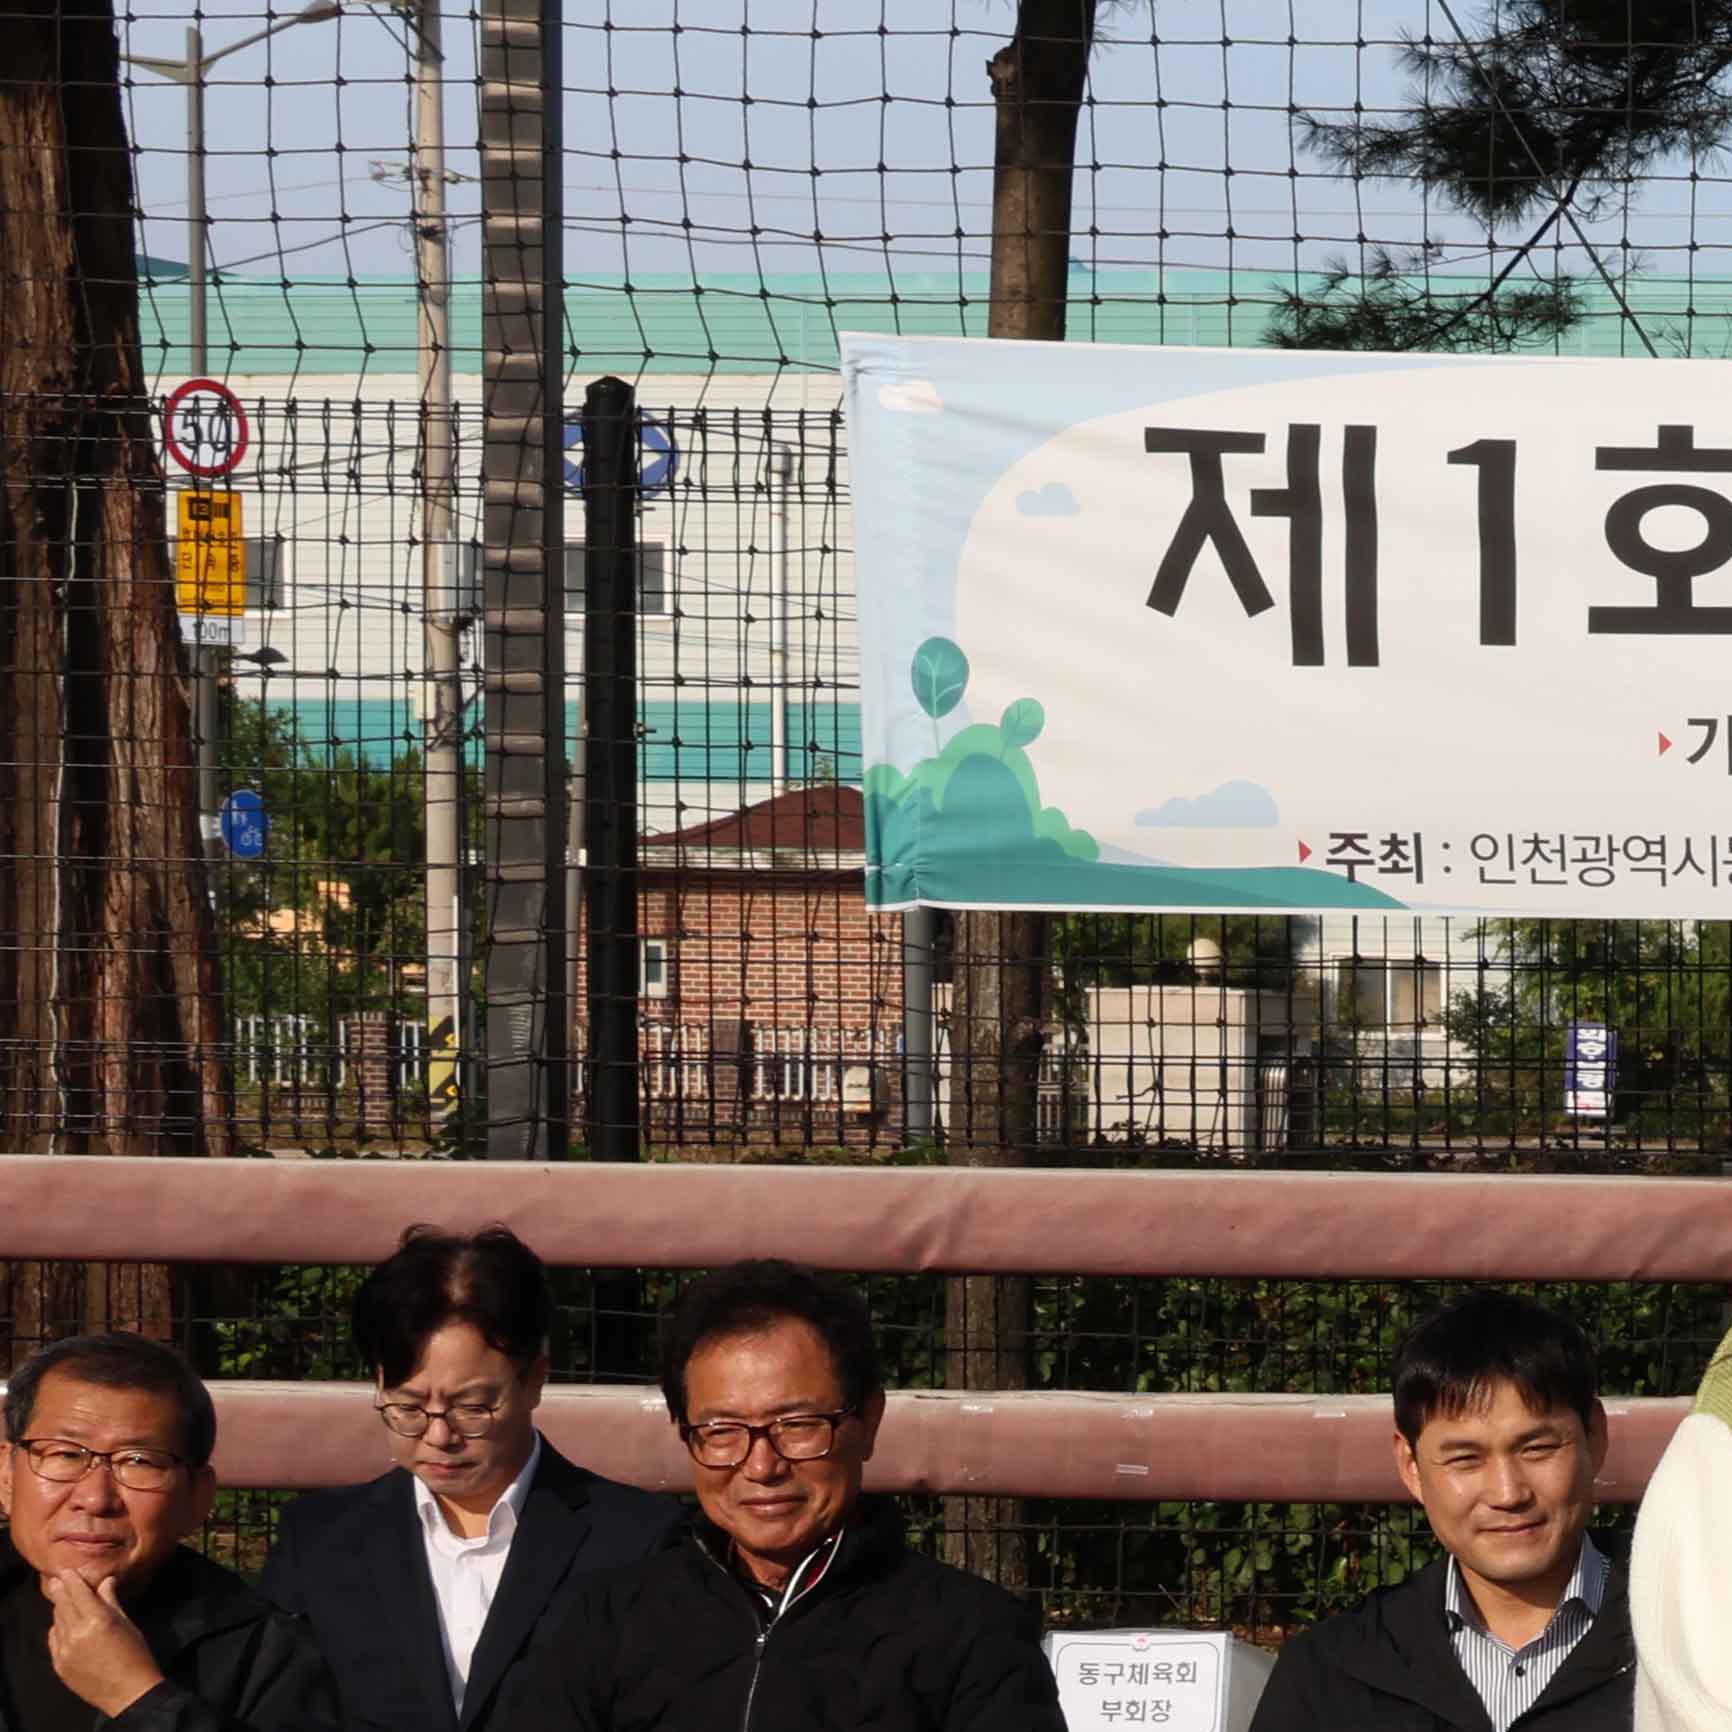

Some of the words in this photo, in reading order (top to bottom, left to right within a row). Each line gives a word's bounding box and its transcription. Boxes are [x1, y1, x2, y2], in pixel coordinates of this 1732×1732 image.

[182, 407, 232, 452] 50
[1325, 831, 1424, 884] 주최
[1079, 1660, 1198, 1686] 동구체육회
[1100, 1699, 1172, 1724] 부회장
